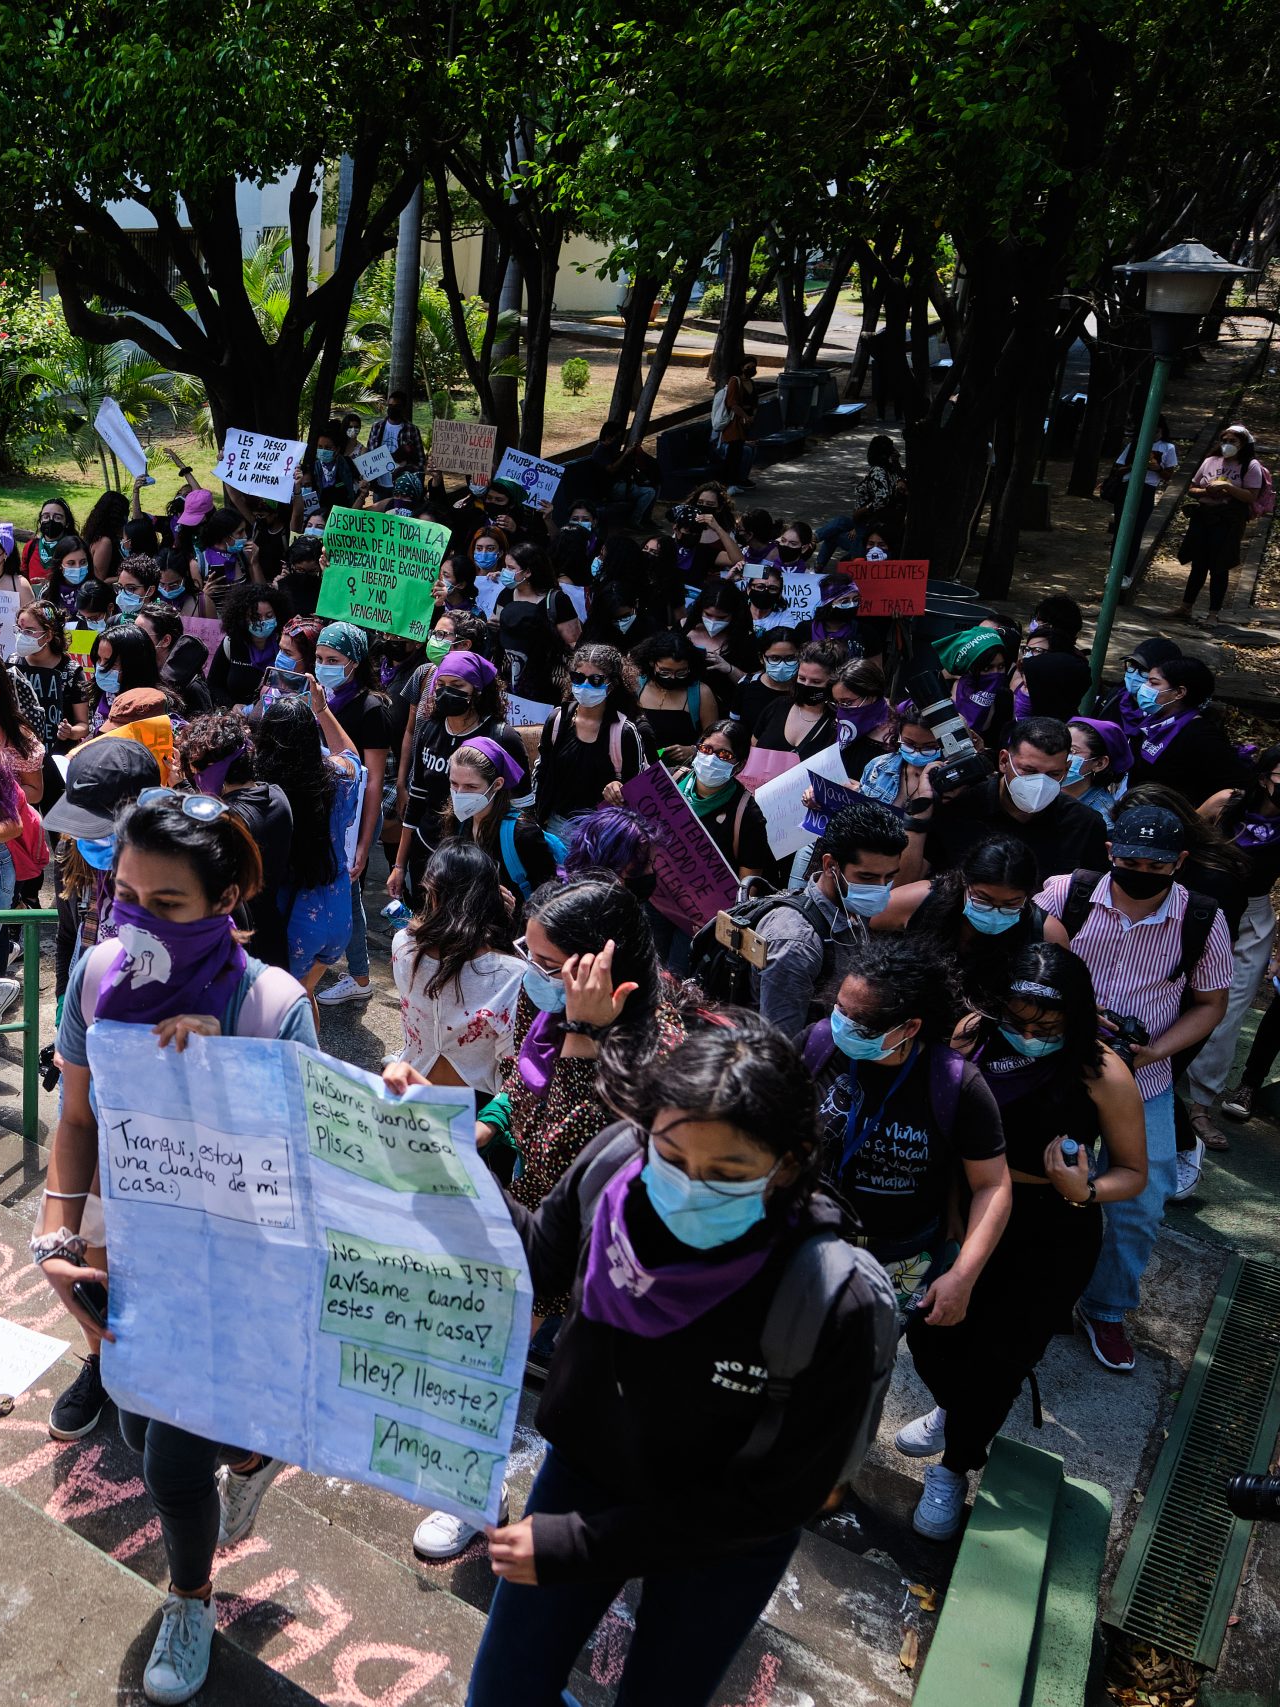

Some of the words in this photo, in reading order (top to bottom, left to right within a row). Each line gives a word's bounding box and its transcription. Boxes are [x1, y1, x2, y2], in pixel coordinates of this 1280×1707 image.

[238, 434, 254, 447] LES
[263, 439, 287, 452] DESEO
[240, 449, 250, 460] EL
[257, 452, 280, 462] VALOR
[225, 470, 233, 478] A
[237, 473, 247, 482] LA
[250, 473, 280, 486] PRIMERA
[239, 462, 250, 471] DE
[253, 462, 272, 471] IRSE
[329, 512, 376, 534] DESPUÉS
[382, 519, 396, 537] DE
[399, 523, 421, 542] TODA
[426, 528, 445, 548] LA
[327, 533, 369, 551] HISTORIA
[372, 539, 384, 554] DE
[386, 544, 396, 557] LA
[398, 546, 441, 566] HUMANIDAD
[329, 550, 377, 569] AGRADEZCAN
[379, 557, 395, 573] QUE
[398, 561, 437, 584] EXIGIMOS
[871, 564, 925, 581] CLIENTES
[361, 571, 398, 590] LIBERTAD
[368, 588, 375, 602] Y
[376, 590, 387, 605] NO
[881, 598, 915, 614] TRATA
[350, 603, 393, 625] VENGANZA
[409, 619, 426, 638] #8M
[647, 766, 682, 817] NUNCA
[679, 813, 729, 886] TENDRAN
[688, 868, 716, 901] DE
[312, 1101, 351, 1128] estes
[357, 1118, 374, 1136] en
[378, 1129, 398, 1147] tu
[407, 1136, 456, 1158] casa
[199, 1144, 244, 1174] estoy
[261, 1157, 278, 1173] a
[888, 1141, 929, 1161] tocan
[114, 1154, 154, 1179] una
[228, 1172, 247, 1193] de
[255, 1177, 280, 1197] mi
[373, 1245, 454, 1282] importa
[327, 1272, 412, 1305] avísame
[326, 1297, 376, 1322] estes
[384, 1308, 408, 1328] en
[416, 1311, 436, 1332] tu
[350, 1349, 404, 1388] Hey?
[412, 1366, 499, 1416] llegaste?
[714, 1360, 744, 1373] NO
[748, 1364, 768, 1380] HA
